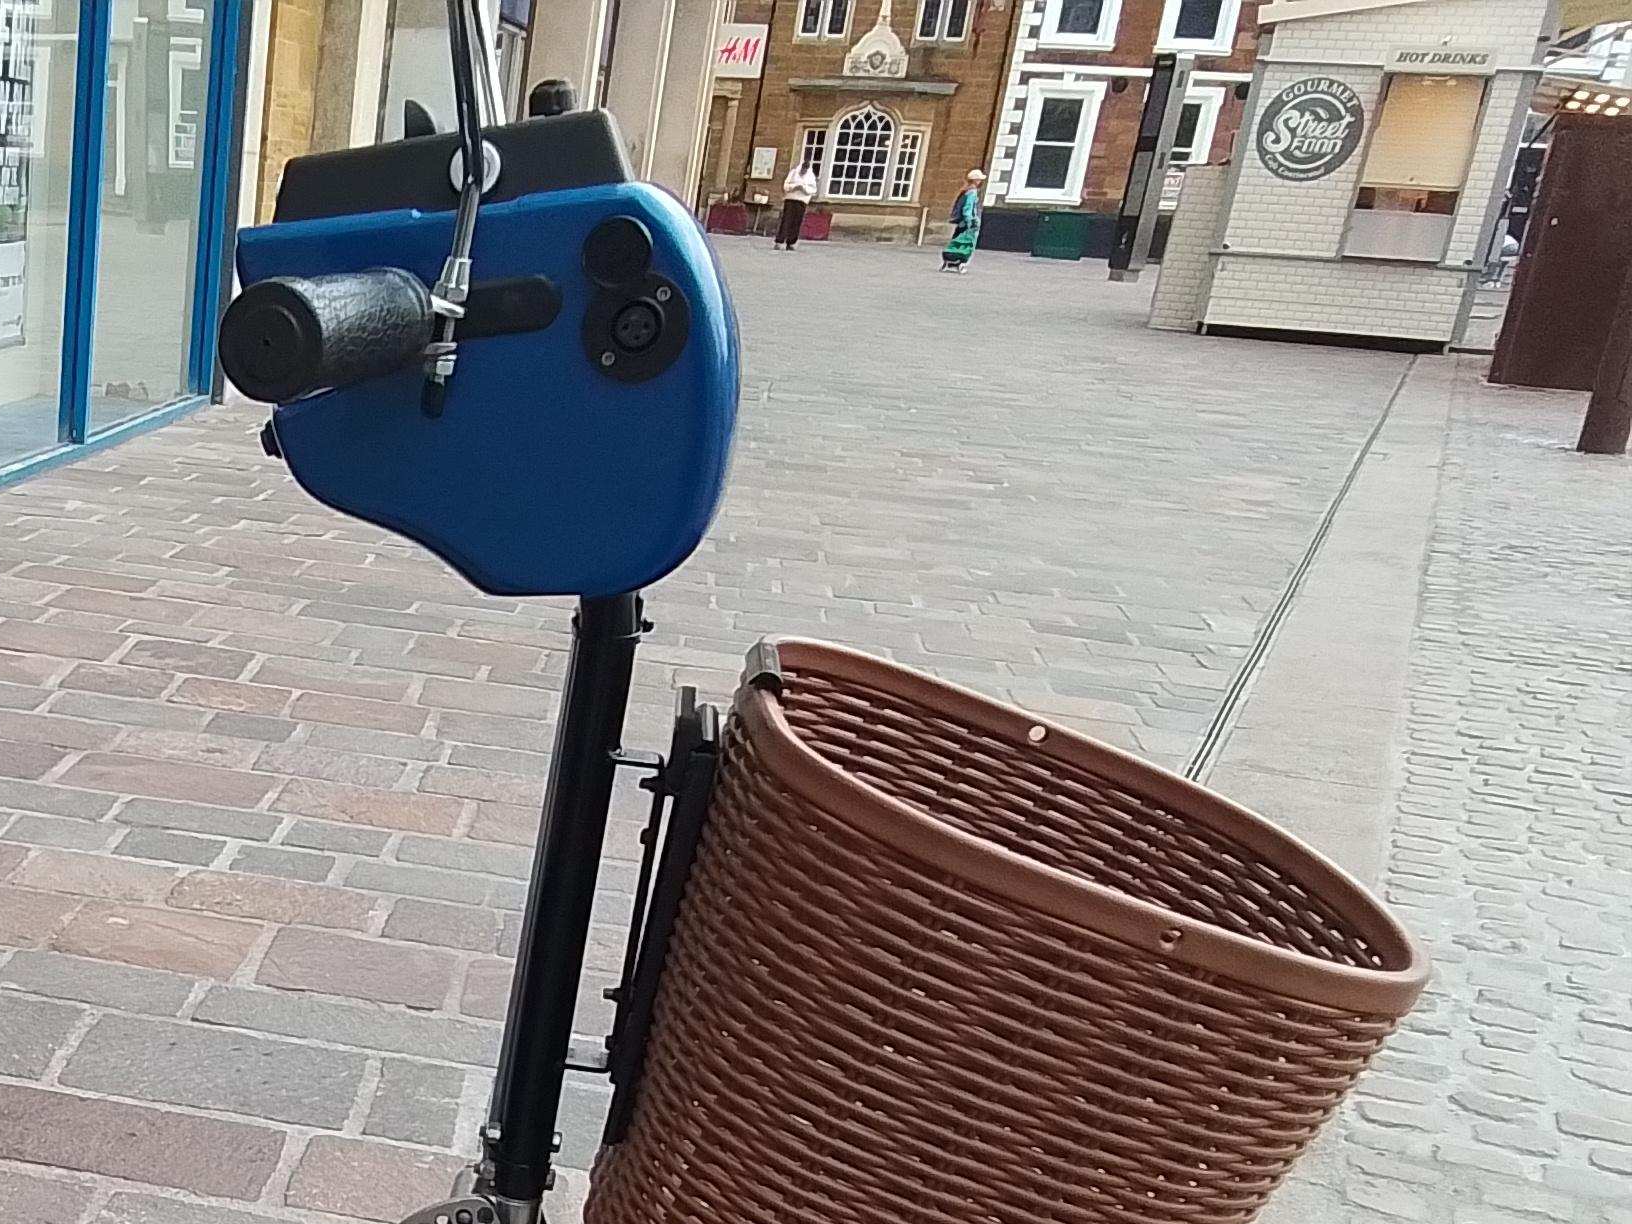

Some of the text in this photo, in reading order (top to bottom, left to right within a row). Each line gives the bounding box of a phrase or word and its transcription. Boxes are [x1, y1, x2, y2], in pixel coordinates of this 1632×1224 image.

[1395, 51, 1489, 66] HOT DRINKS
[1282, 80, 1360, 108] GOURMET
[1263, 109, 1356, 153] Street
